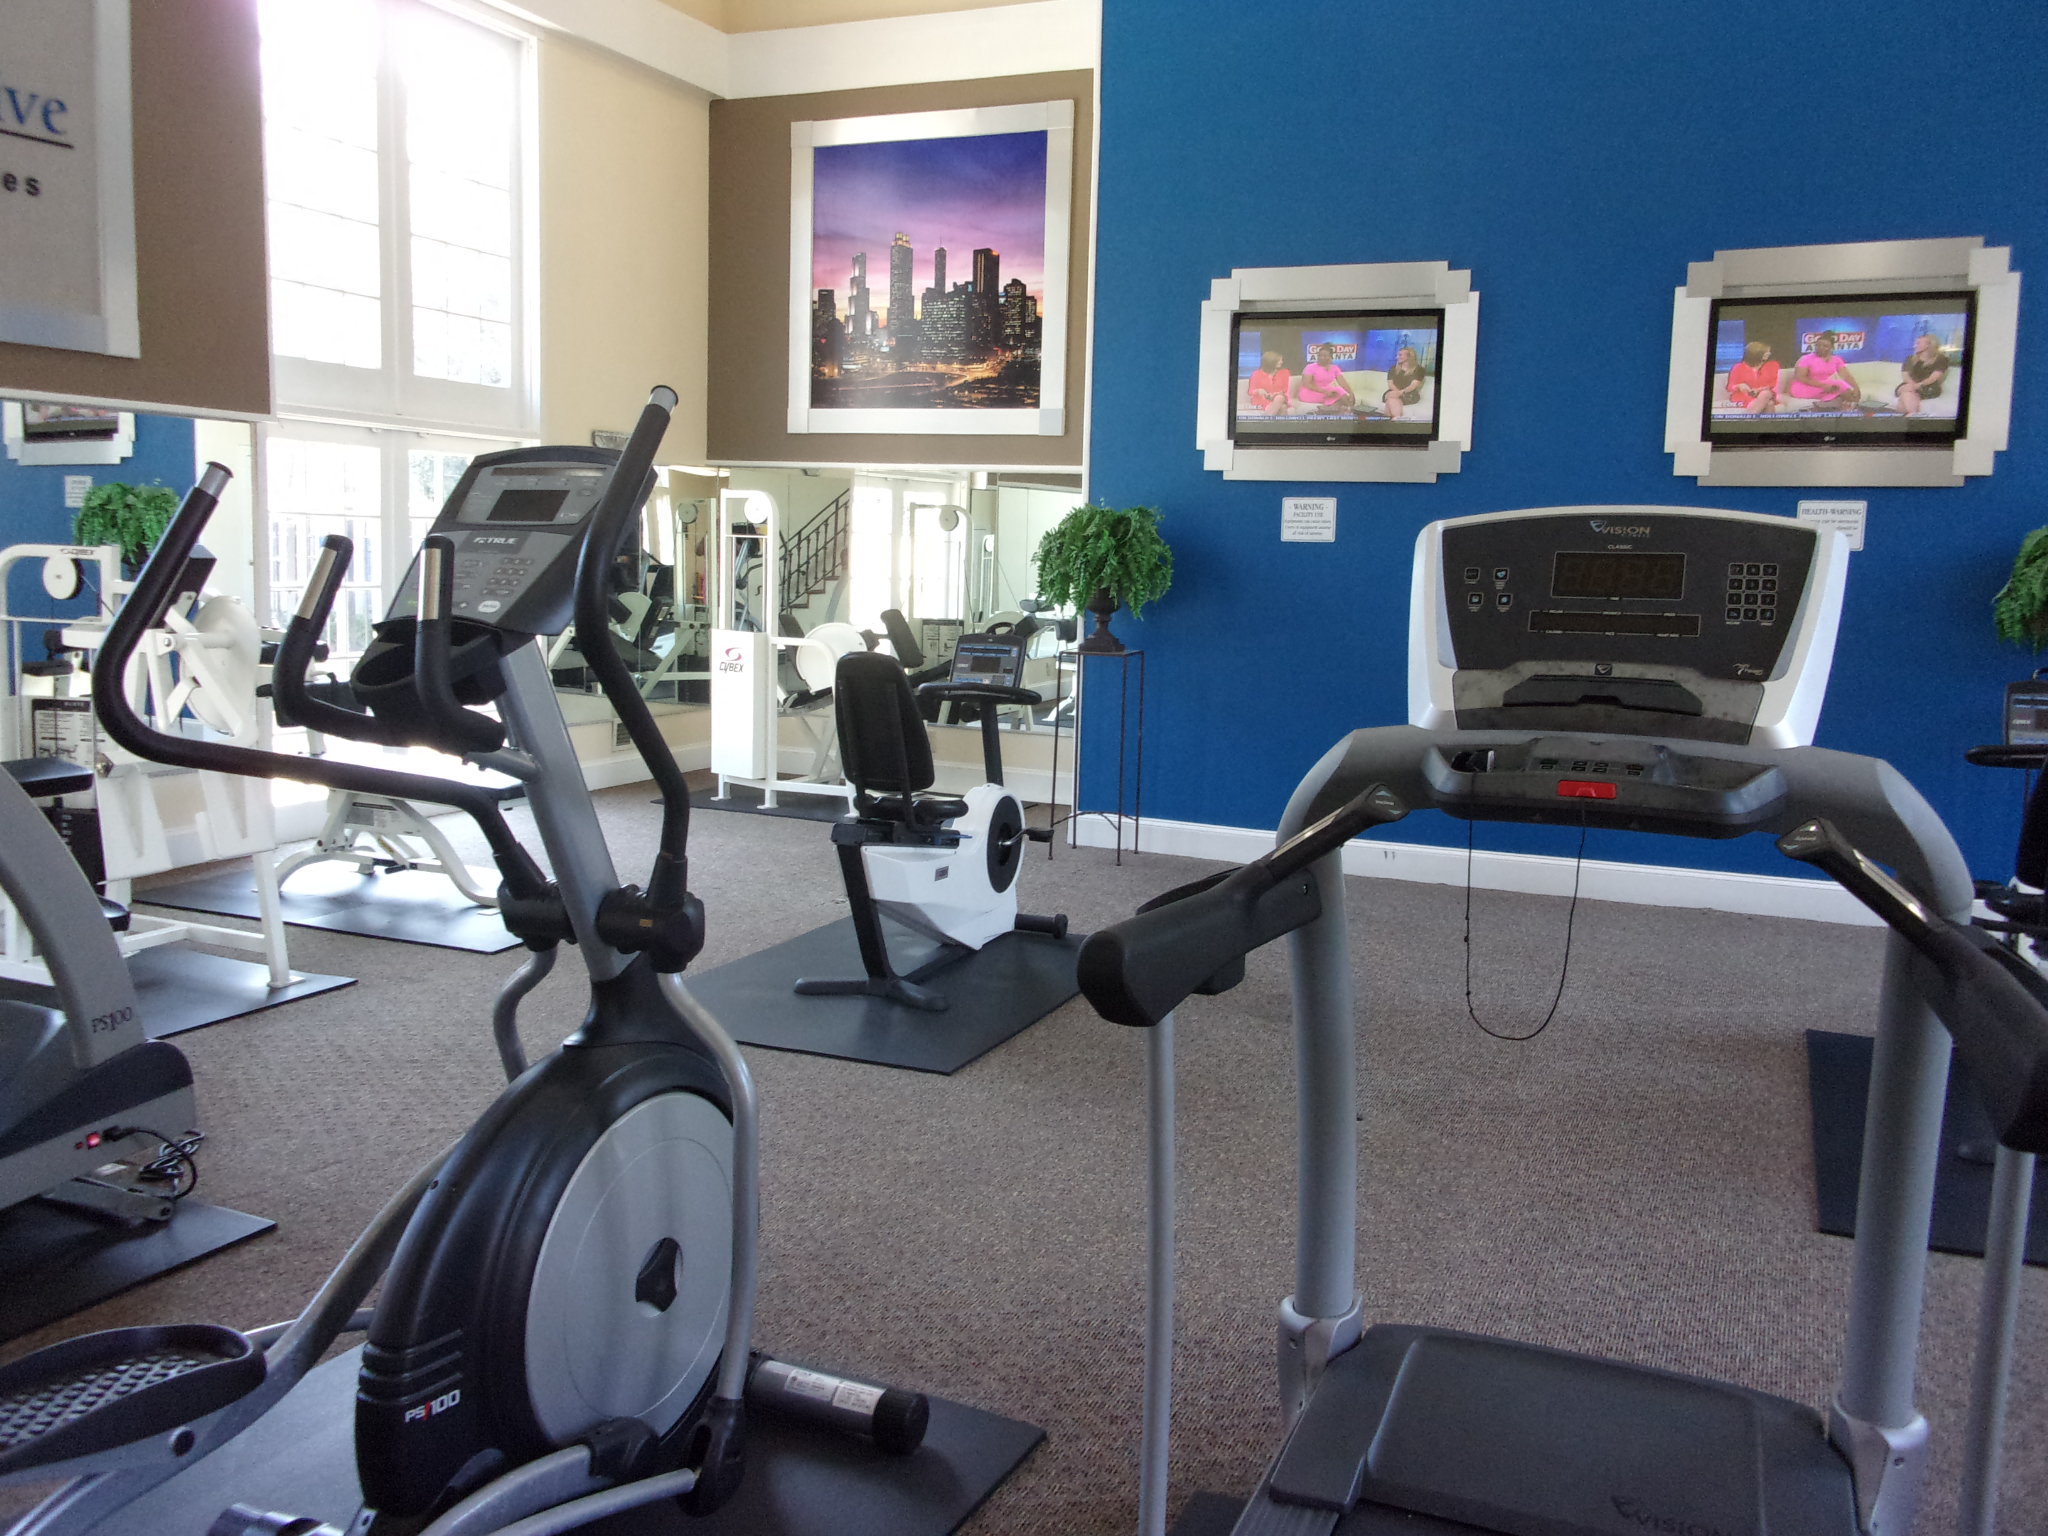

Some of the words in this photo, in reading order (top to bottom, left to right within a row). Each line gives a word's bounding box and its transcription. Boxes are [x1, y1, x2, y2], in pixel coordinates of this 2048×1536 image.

[0, 86, 69, 135] ve
[1293, 503, 1325, 511] WARNING
[1602, 526, 1651, 534] VISION
[719, 661, 744, 674] CYBEX
